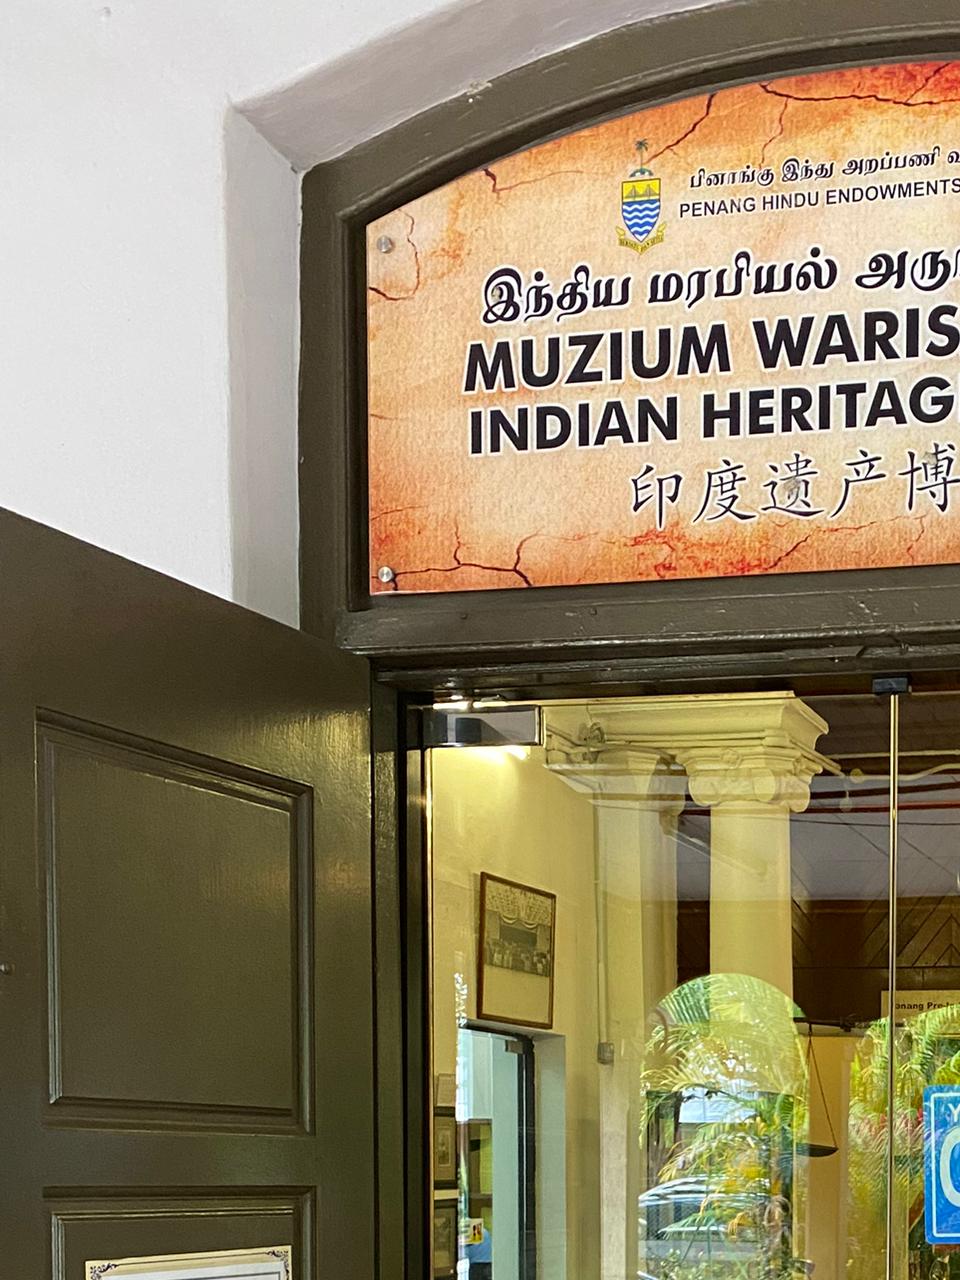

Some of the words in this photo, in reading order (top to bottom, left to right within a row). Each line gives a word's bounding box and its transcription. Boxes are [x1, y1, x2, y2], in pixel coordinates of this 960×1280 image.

[690, 164, 775, 191] பினாங்கு
[781, 157, 834, 184] இந்து
[841, 145, 941, 177] அறப்பணி
[679, 196, 757, 219] PENANG
[762, 191, 819, 212] HINDU
[482, 266, 631, 325] இந்திய
[648, 247, 837, 304] மரபியல்
[463, 324, 731, 392] MUZIUM
[469, 397, 678, 455] INDIAN
